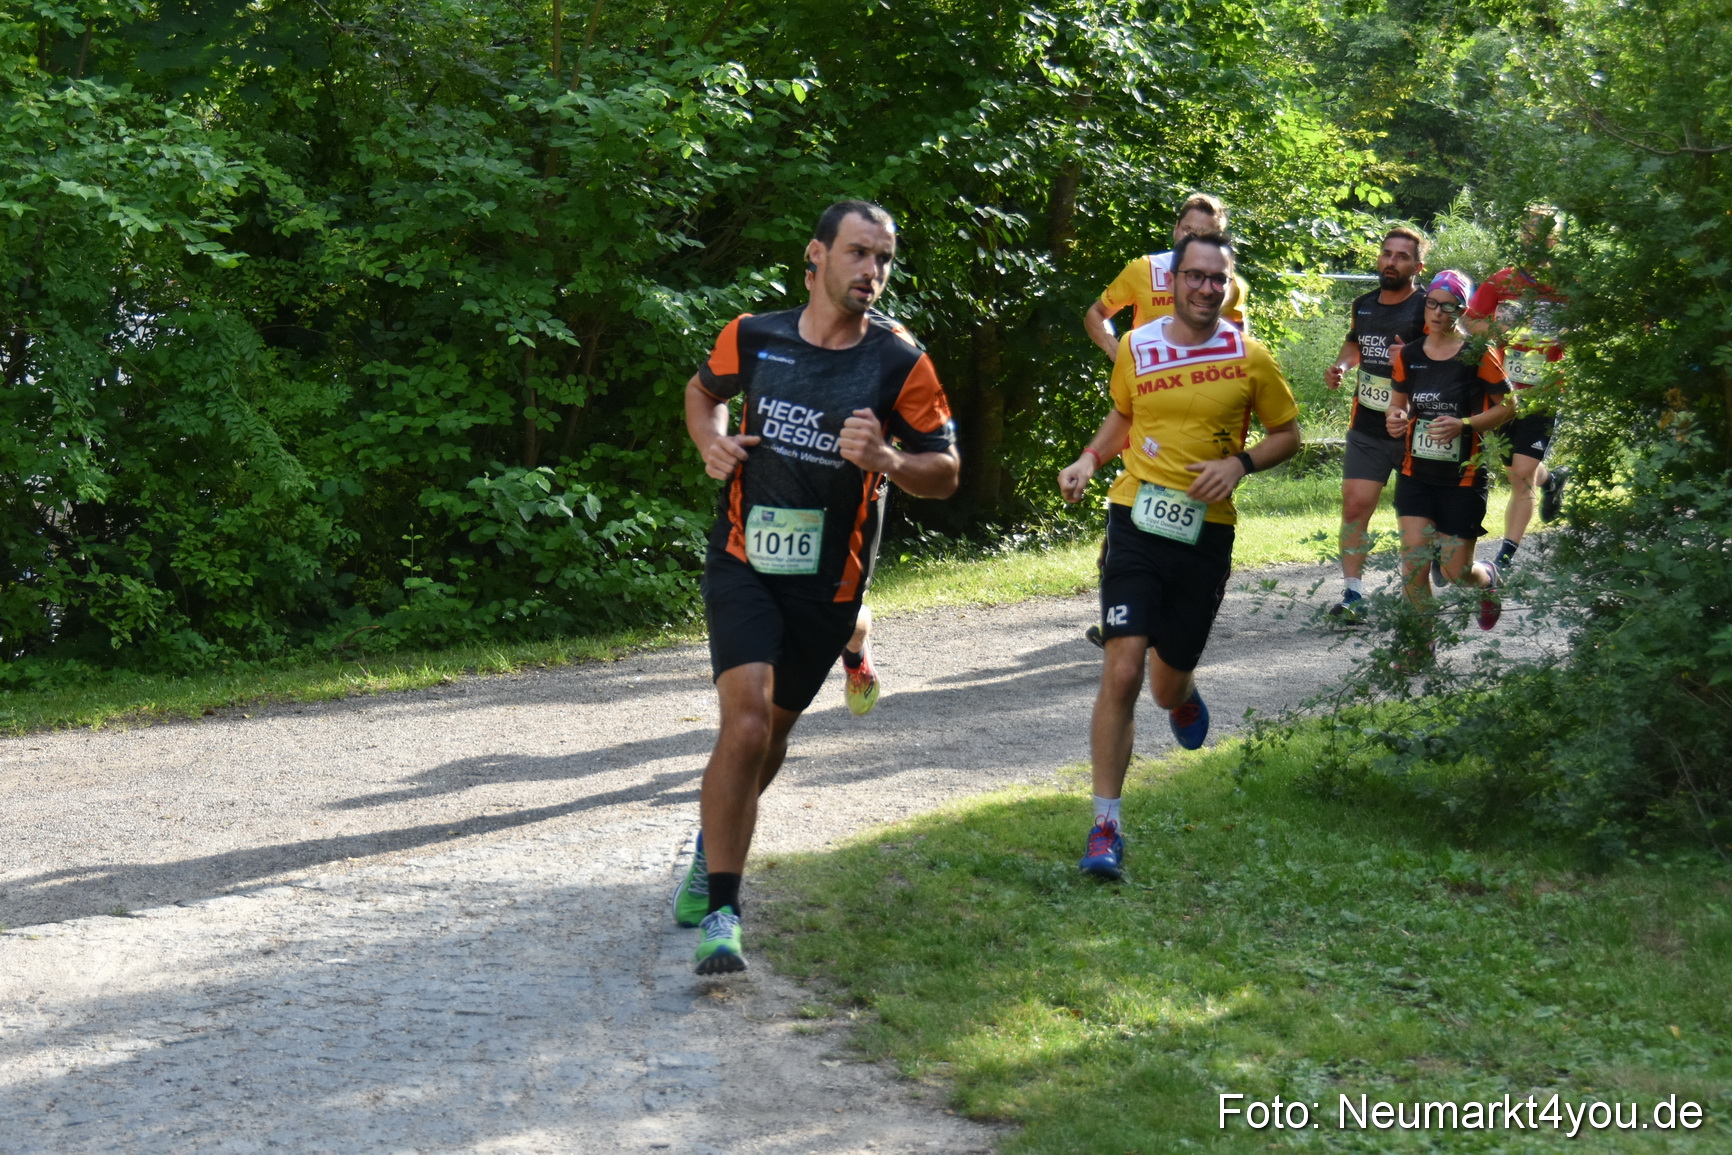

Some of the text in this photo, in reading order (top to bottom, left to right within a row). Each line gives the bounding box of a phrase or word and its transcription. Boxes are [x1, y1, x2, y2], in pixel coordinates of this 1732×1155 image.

[1152, 297, 1175, 306] MA
[1358, 335, 1387, 347] HECK
[1136, 365, 1247, 396] MAX BÖGL
[1360, 383, 1390, 403] 2439
[1412, 392, 1441, 402] HECK
[757, 397, 825, 429] HECK
[1416, 401, 1458, 411] DESIGN
[1143, 496, 1196, 527] 1685
[753, 530, 811, 556] 1016
[1106, 604, 1127, 626] 42
